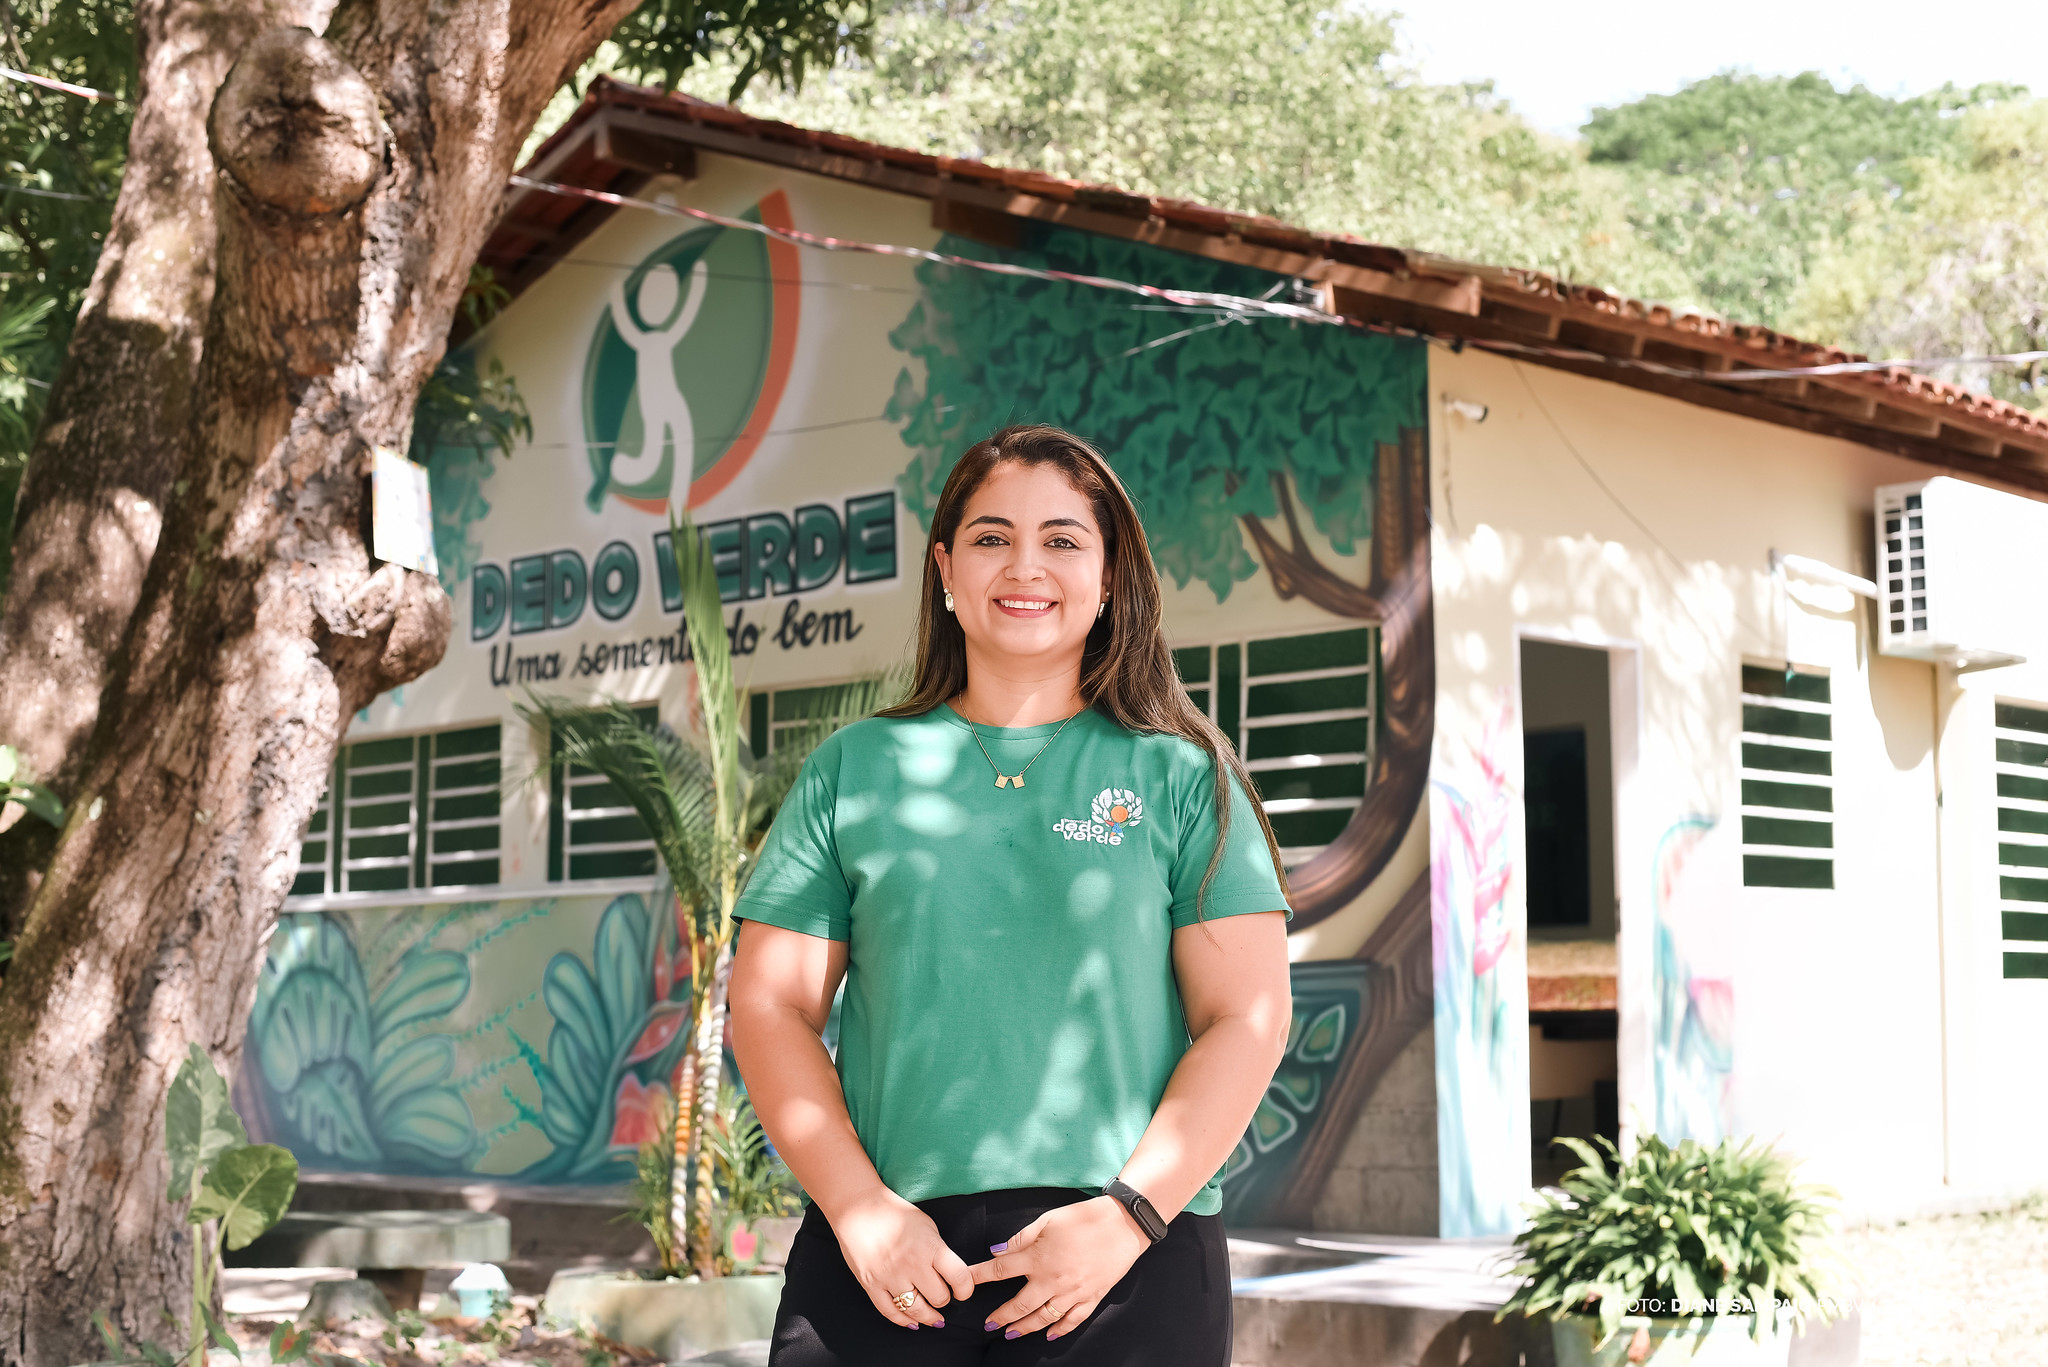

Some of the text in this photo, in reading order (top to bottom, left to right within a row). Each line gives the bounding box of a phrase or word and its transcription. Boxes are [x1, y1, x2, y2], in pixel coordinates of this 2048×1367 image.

[472, 540, 640, 642] DEDO
[489, 641, 565, 687] Uma
[571, 616, 696, 678] sement
[772, 598, 864, 649] bem
[1052, 818, 1104, 834] dedo
[1063, 830, 1122, 846] verde
